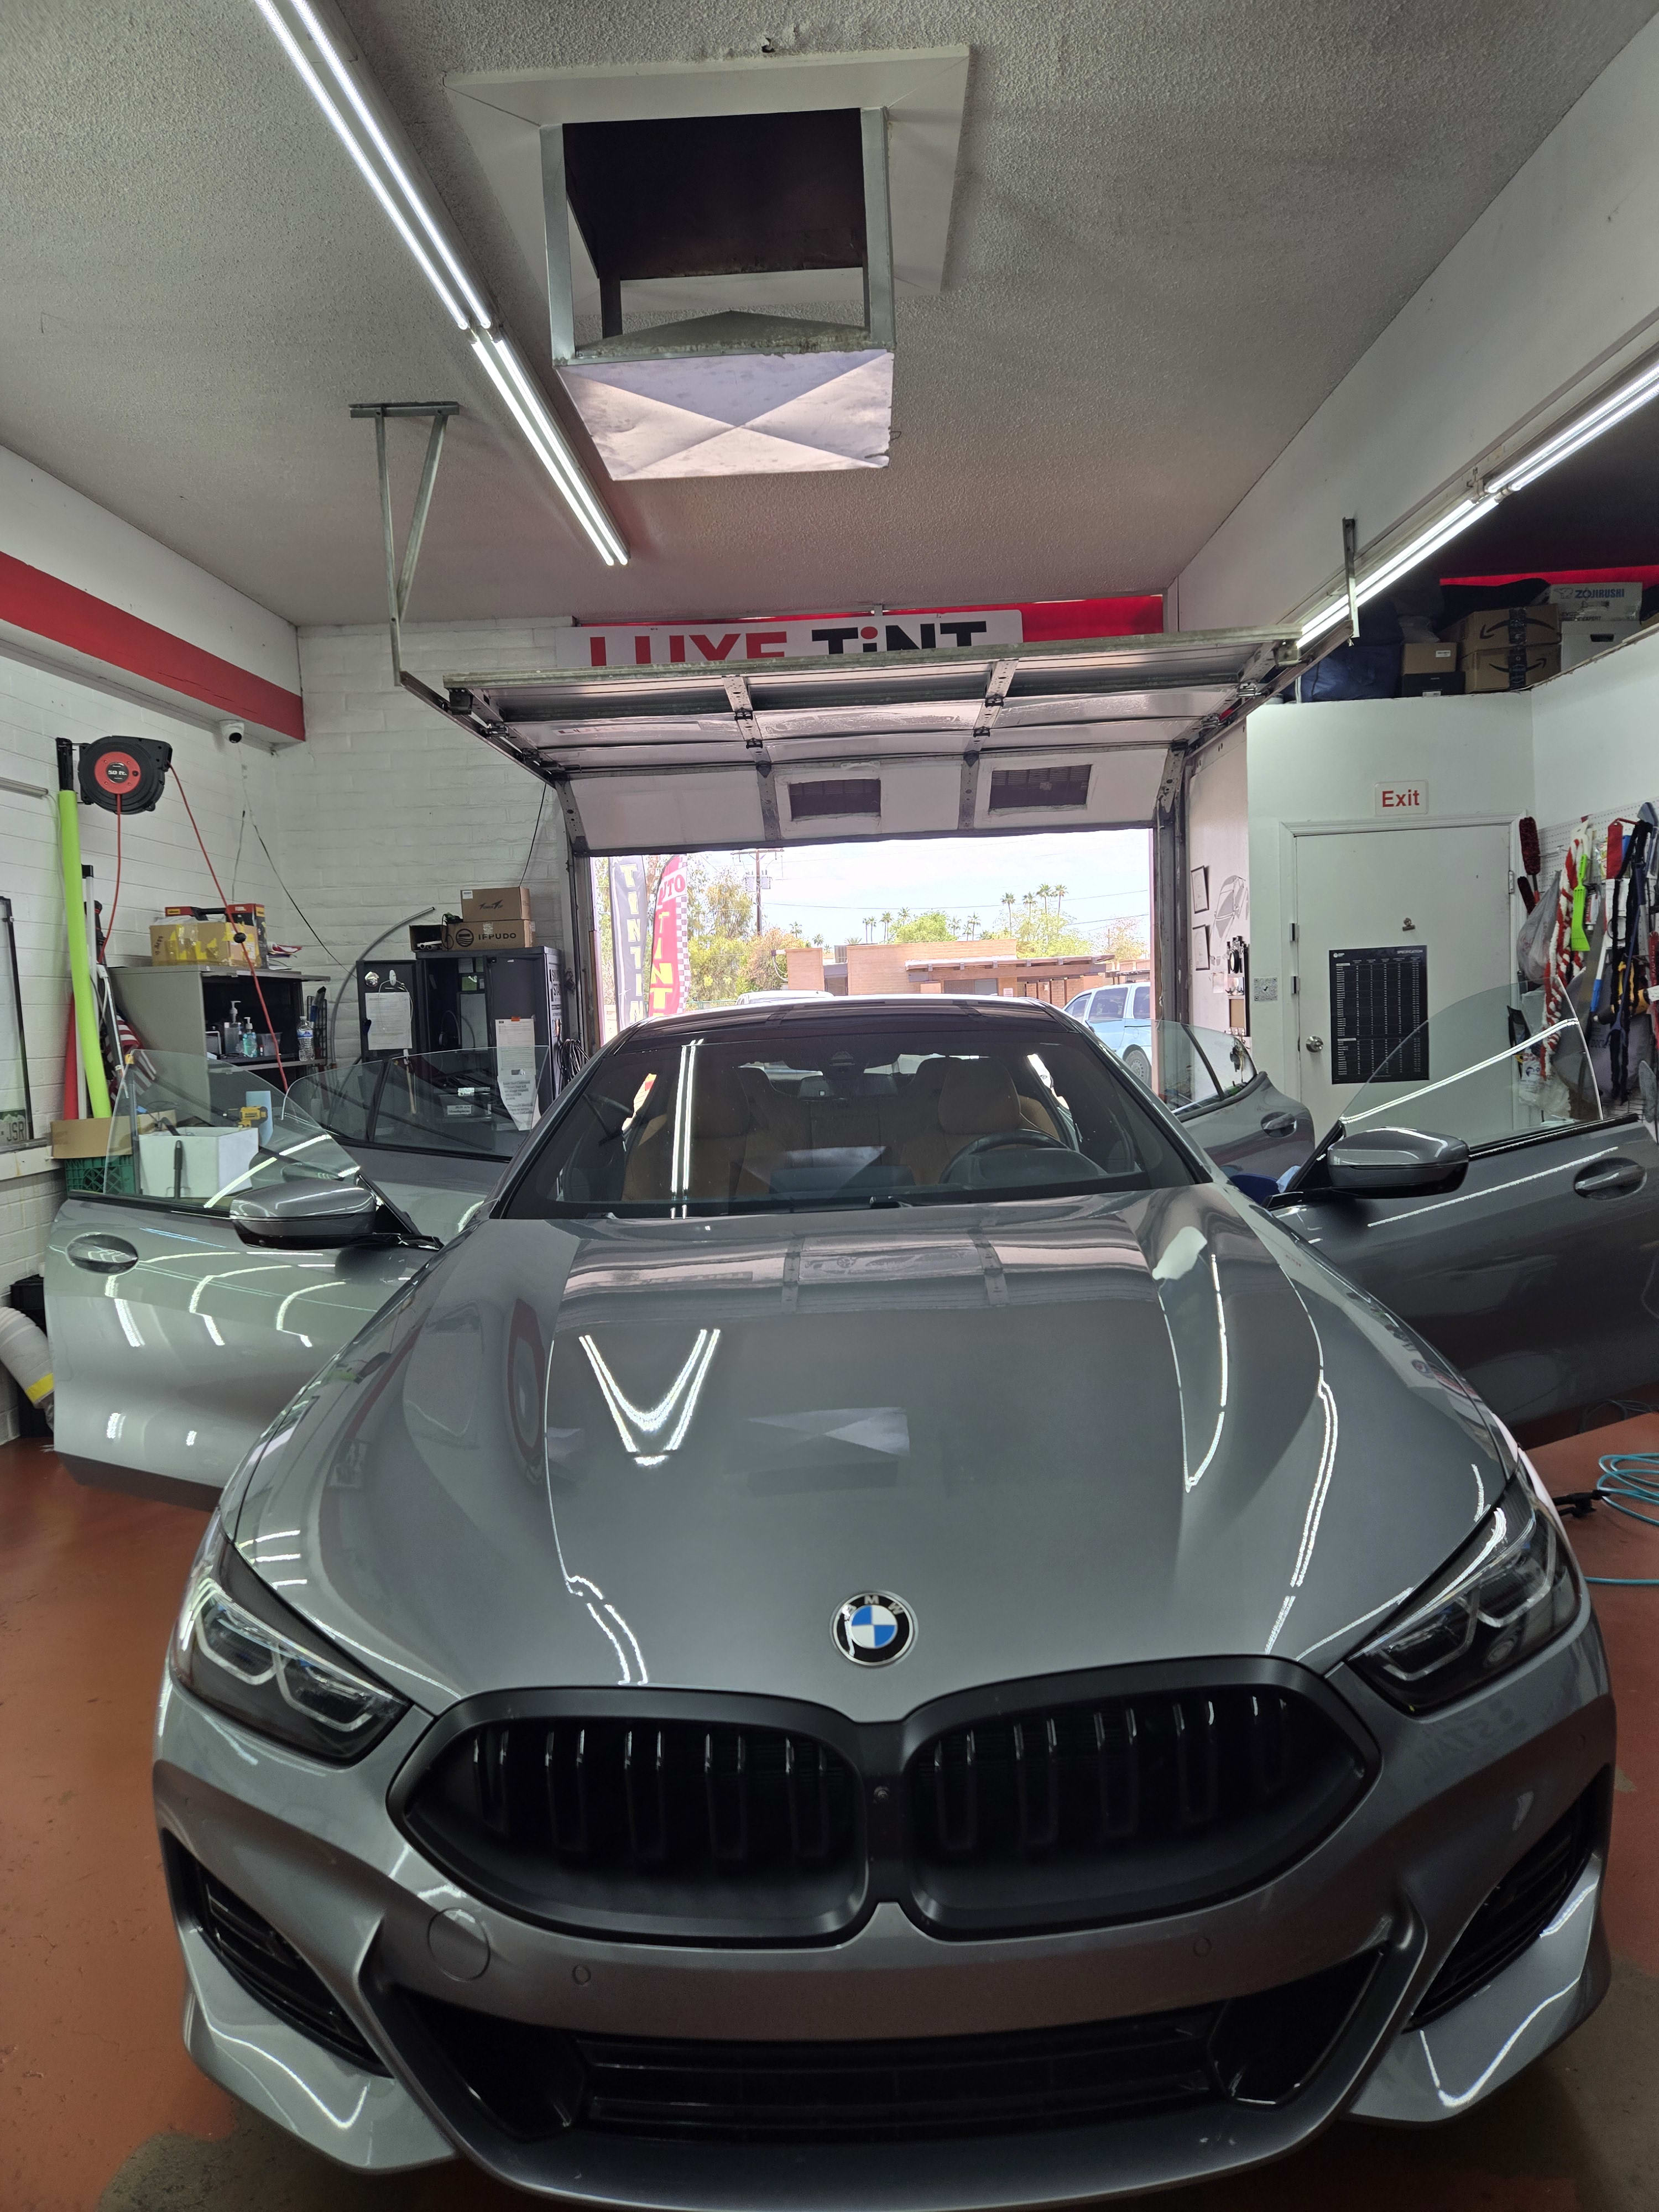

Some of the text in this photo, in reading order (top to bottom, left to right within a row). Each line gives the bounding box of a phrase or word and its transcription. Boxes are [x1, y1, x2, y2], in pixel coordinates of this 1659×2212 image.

[1575, 588, 1625, 598] ZOJIRUSHI
[1383, 789, 1420, 807] Exit
[841, 1594, 904, 1615] BMW
